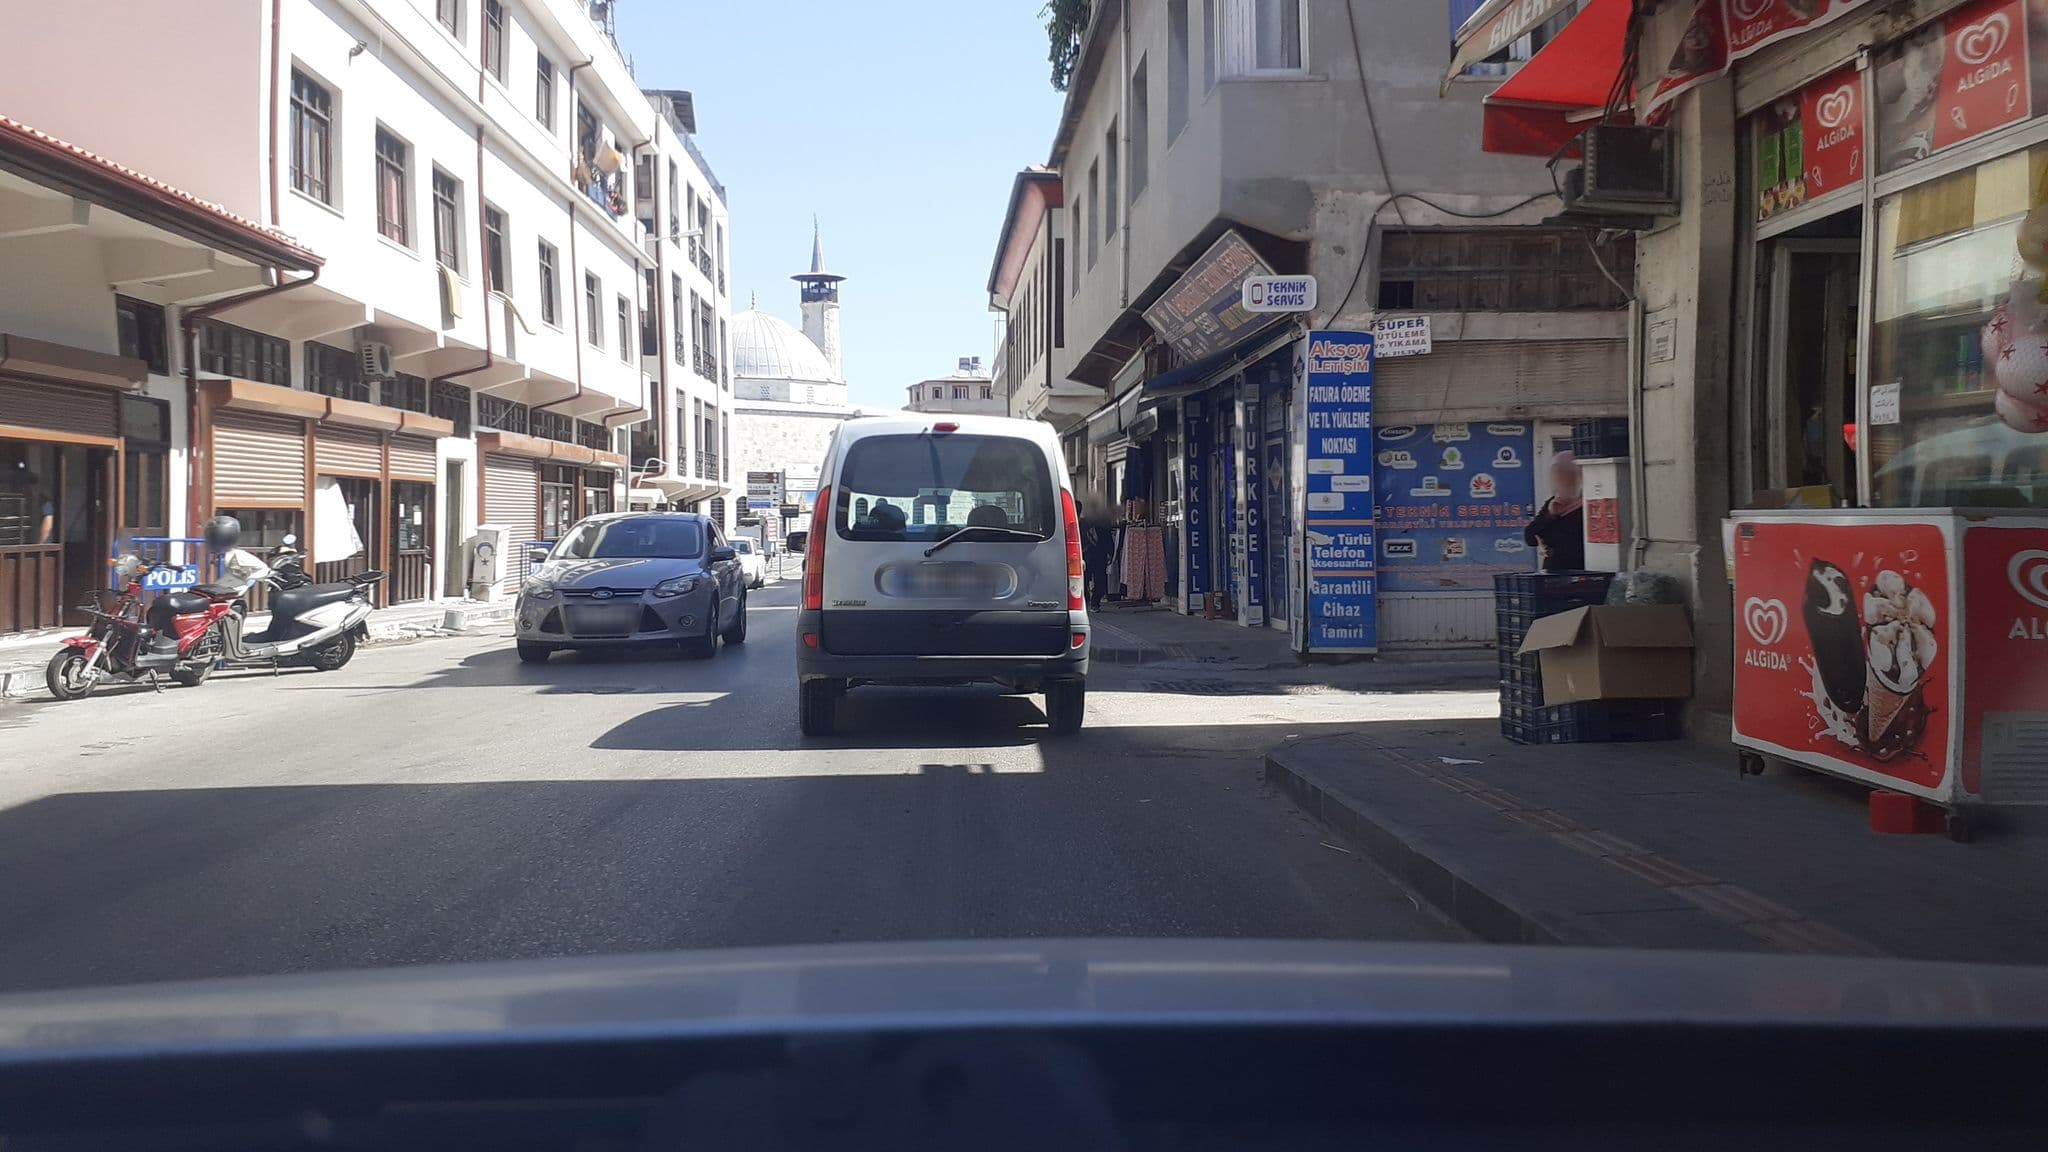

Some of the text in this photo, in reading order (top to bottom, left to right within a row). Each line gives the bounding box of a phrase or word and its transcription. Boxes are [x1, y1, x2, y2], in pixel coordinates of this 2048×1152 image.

[1310, 340, 1371, 360] Aksoy
[1309, 382, 1370, 403] FATURA ÖDEME
[1309, 412, 1320, 428] VE
[1331, 408, 1370, 428] YÜKLEME
[1322, 438, 1357, 454] NOKTASI
[1394, 454, 1408, 462] LG
[1187, 420, 1201, 592] TURKCELL
[1246, 406, 1259, 604] TURKCELL
[1314, 547, 1365, 559] Telefon
[1312, 580, 1372, 595] Garantili
[1323, 601, 1360, 617] Cihaz
[1321, 624, 1363, 639] Tamiri
